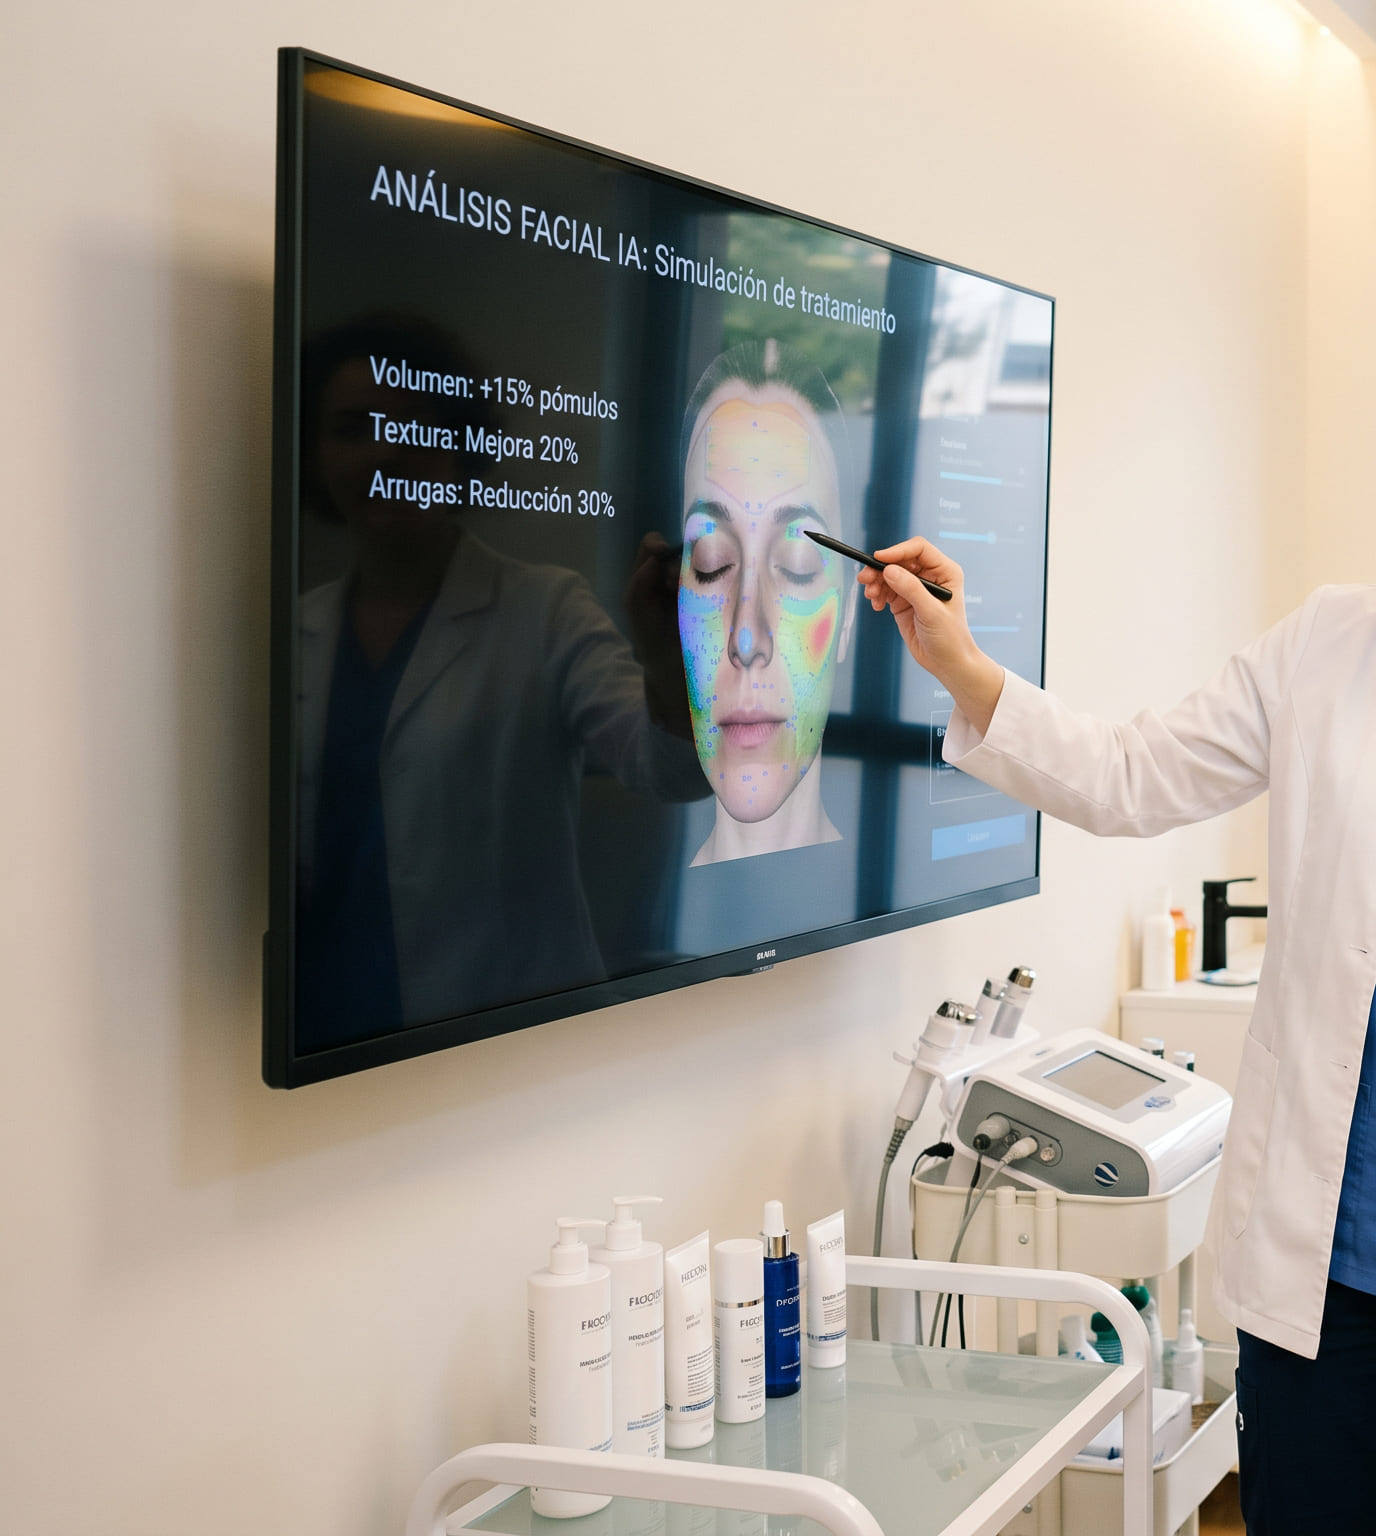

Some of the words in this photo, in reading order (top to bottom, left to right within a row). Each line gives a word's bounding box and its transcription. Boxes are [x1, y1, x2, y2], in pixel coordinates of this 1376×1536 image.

[370, 165, 511, 234] ANÁLISIS
[521, 206, 610, 261] FACIAL
[618, 233, 648, 271] IA:
[655, 243, 767, 303] Simulación
[773, 277, 796, 310] de
[800, 286, 896, 335] tratamiento
[370, 356, 473, 399] Volumen:
[480, 376, 534, 408] +15%
[539, 386, 618, 421] pómulos
[370, 412, 458, 451] Textura:
[466, 426, 534, 463] Mejora
[539, 436, 578, 465] 20%
[369, 470, 462, 510] Arrugas:
[470, 480, 572, 513] Reducción
[577, 489, 615, 518] 30%
